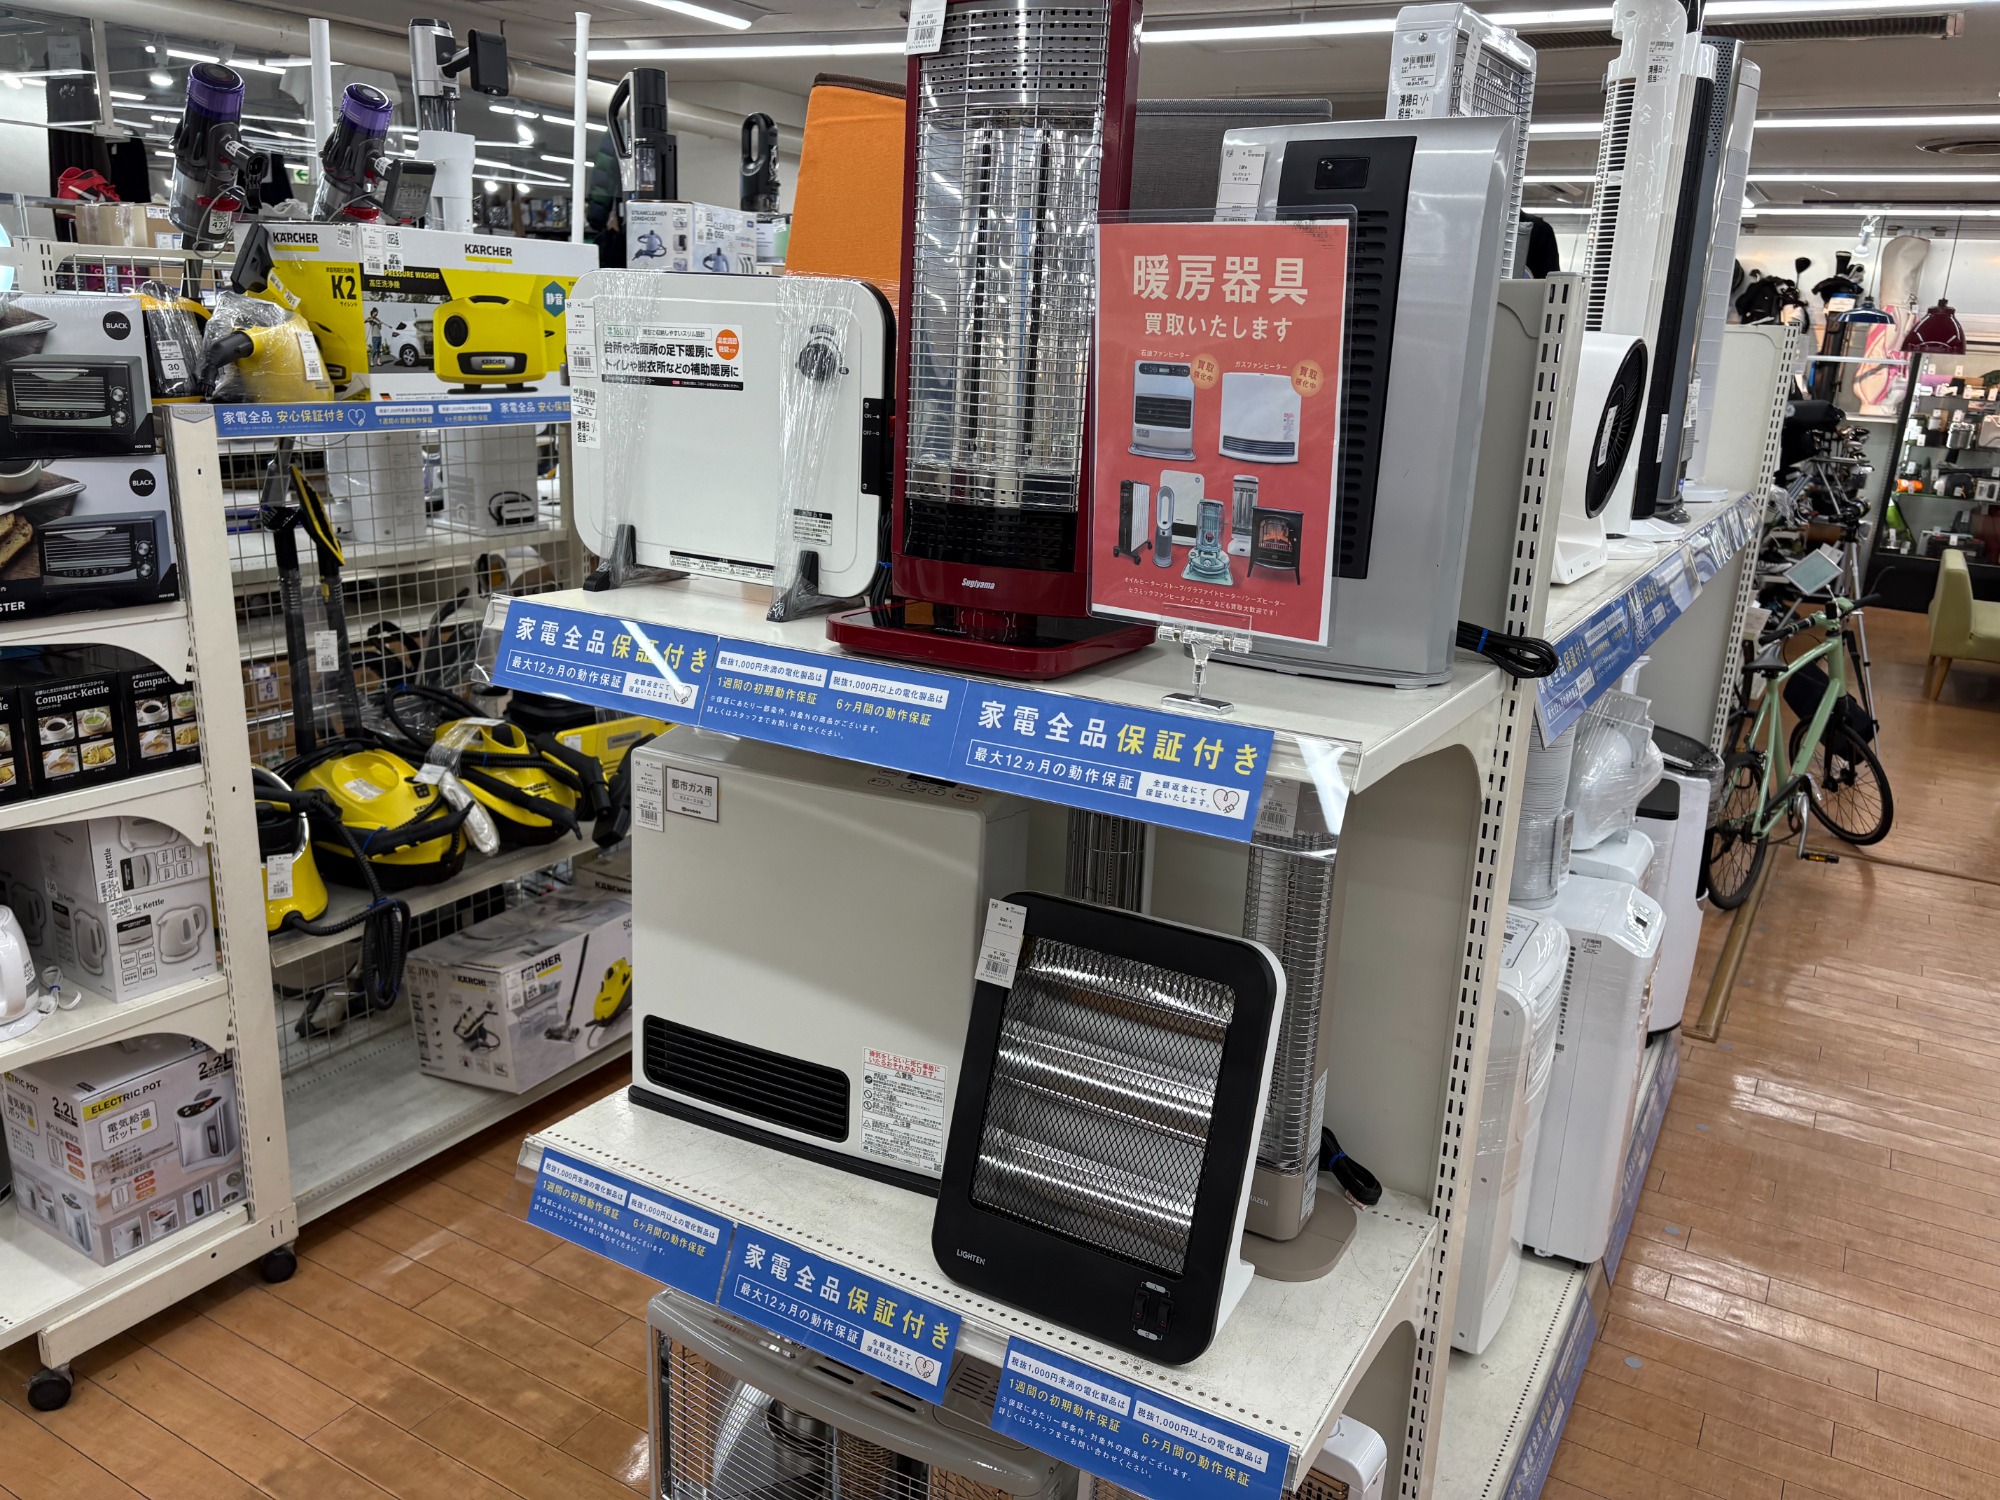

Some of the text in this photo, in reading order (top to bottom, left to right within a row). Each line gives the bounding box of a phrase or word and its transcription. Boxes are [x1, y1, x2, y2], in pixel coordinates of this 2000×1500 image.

[273, 231, 319, 244] KÄRCHER
[464, 243, 513, 257] KÄRCHER
[368, 279, 401, 289] 高圧洗浄機
[384, 269, 440, 280] PRESSURE WASHER
[1133, 254, 1309, 305] 暖房器具
[331, 275, 357, 300] K2
[546, 292, 563, 306] 静音
[106, 322, 128, 330] BLACK
[1145, 312, 1293, 342] 買取いたします
[603, 341, 714, 358] 台所や洗面所の足下暖房に
[1140, 350, 1190, 358] 石油ファンヒーター
[167, 363, 180, 371] 30
[604, 359, 739, 377] トイレや脱衣所などの補助暖房に
[1197, 360, 1214, 373] 買取
[1234, 360, 1287, 370] ガスファンヒーター
[1299, 366, 1318, 381] 買取
[222, 410, 273, 425] 家電全品
[276, 409, 344, 424] 安心保証付き
[500, 402, 536, 414] 家電全品
[961, 577, 996, 590] Sugiyama
[515, 617, 708, 673] 家電全品保証付き
[511, 655, 621, 688] 最大12ヵ月の動作保証
[719, 656, 823, 682] 税抜1,000円未満の電化製品は
[35, 686, 110, 705] Compact-Kettle
[633, 678, 671, 691] 全額返金にて
[717, 676, 818, 705] 1週間の初期動作保証
[833, 676, 944, 703] 税抜1,000円以上の電化製品は
[835, 698, 932, 727] 6ヶ月間の動作保証
[977, 700, 1259, 776] 家電全品保証付き
[973, 746, 1135, 792] 最大12ヵ月の動作保証
[671, 779, 713, 797] 都市ガス用
[1145, 788, 1211, 809] 保証いたします。
[1152, 779, 1208, 797] 全額返金にて
[143, 898, 165, 910] Kettle
[198, 1053, 232, 1075] 2.2L
[26, 1081, 39, 1095] POT
[91, 1080, 162, 1114] ELECTRIC POT
[7, 1094, 33, 1117] 電気給湯
[8, 1106, 26, 1121] ポット
[52, 1096, 77, 1121] 2.2L
[106, 1109, 151, 1134] 電気給湯
[108, 1126, 138, 1144] ポット
[545, 1162, 624, 1201] 税抜1,000円未満の電化製品は
[542, 1179, 620, 1220] 1週間の初期動作保証
[631, 1198, 716, 1239] 税抜1,000円以上の電化製品は
[956, 1248, 986, 1266] LIGHTEN
[743, 1243, 950, 1350] 家電全品保証付き
[739, 1282, 858, 1345] 最大12ヵ月の動作保証
[866, 1345, 914, 1371] 保証いたします。
[871, 1337, 912, 1361] 全額返金にて
[1010, 1356, 1126, 1410] 税抜1,000円未満の電化製品は
[1008, 1378, 1122, 1433] 1週間の初期動作保証
[1137, 1407, 1264, 1465] 税抜1,000円以上の電化製品は
[1141, 1432, 1251, 1488] 6ヶ月間の動作保証
